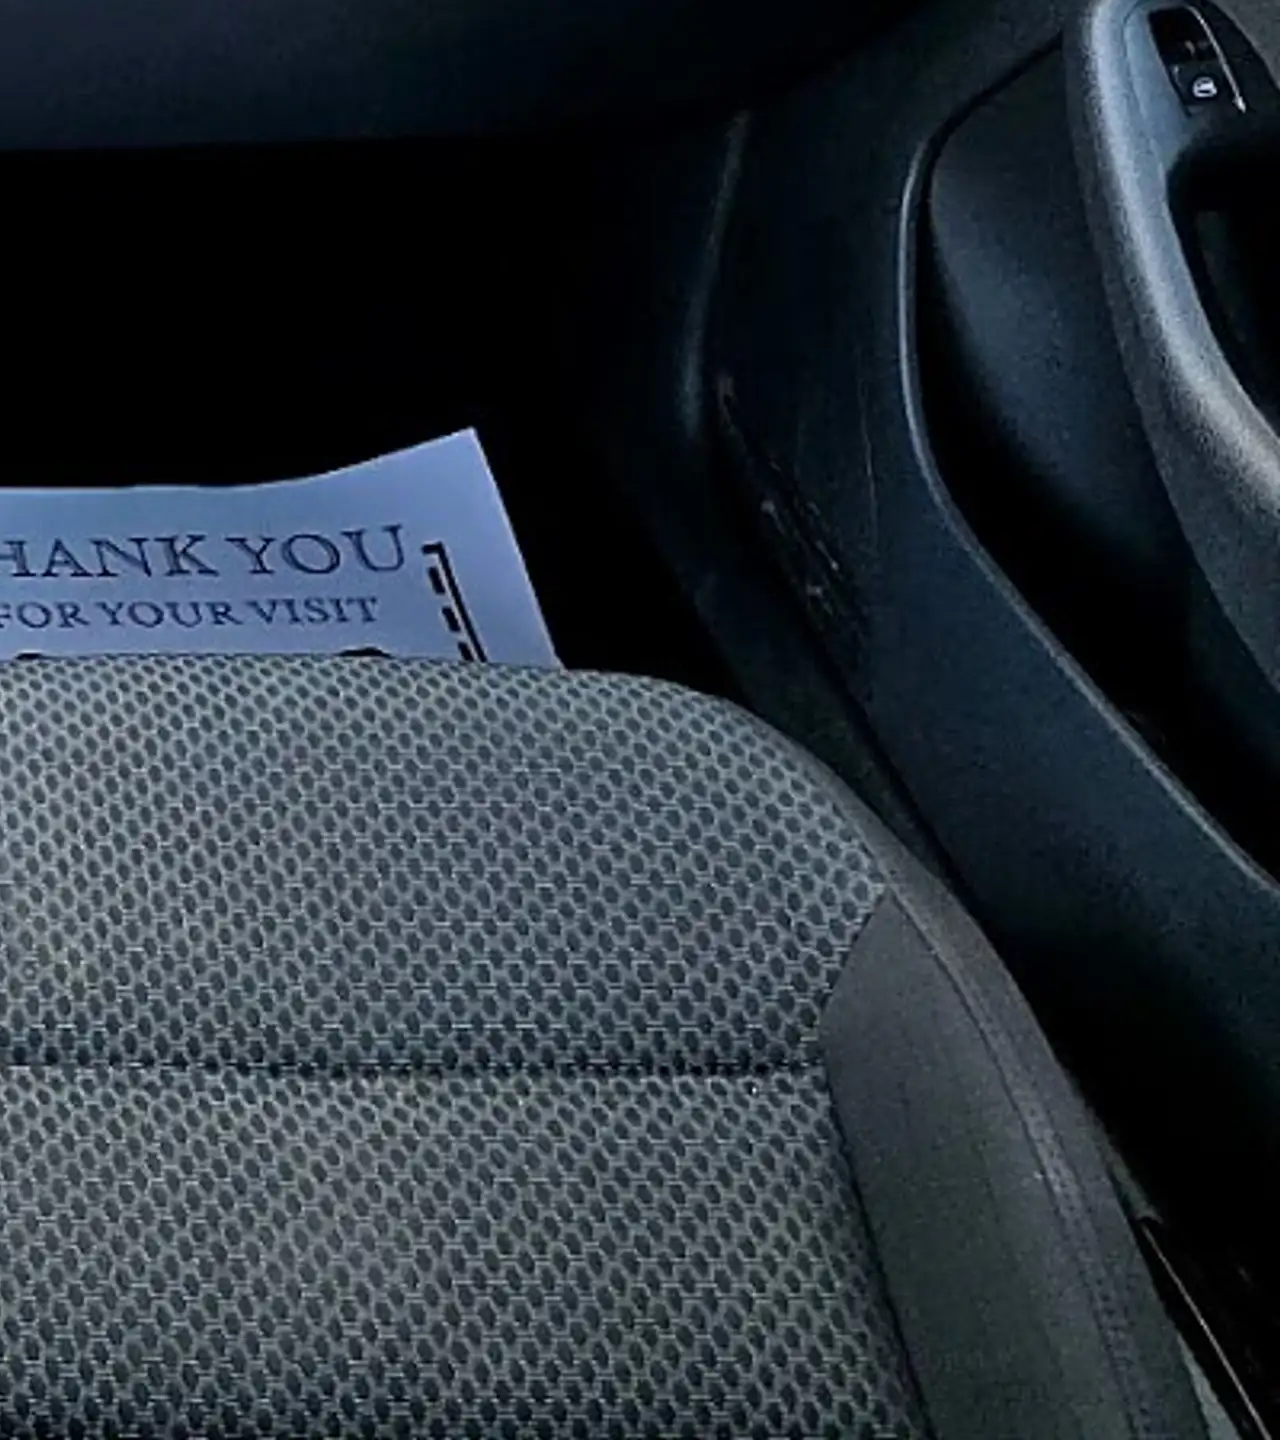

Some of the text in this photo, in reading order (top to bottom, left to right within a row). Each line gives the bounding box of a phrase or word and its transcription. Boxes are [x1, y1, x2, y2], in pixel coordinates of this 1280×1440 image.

[225, 524, 408, 576] YOU
[94, 599, 245, 629] YOUR
[247, 596, 380, 625] VISIT
